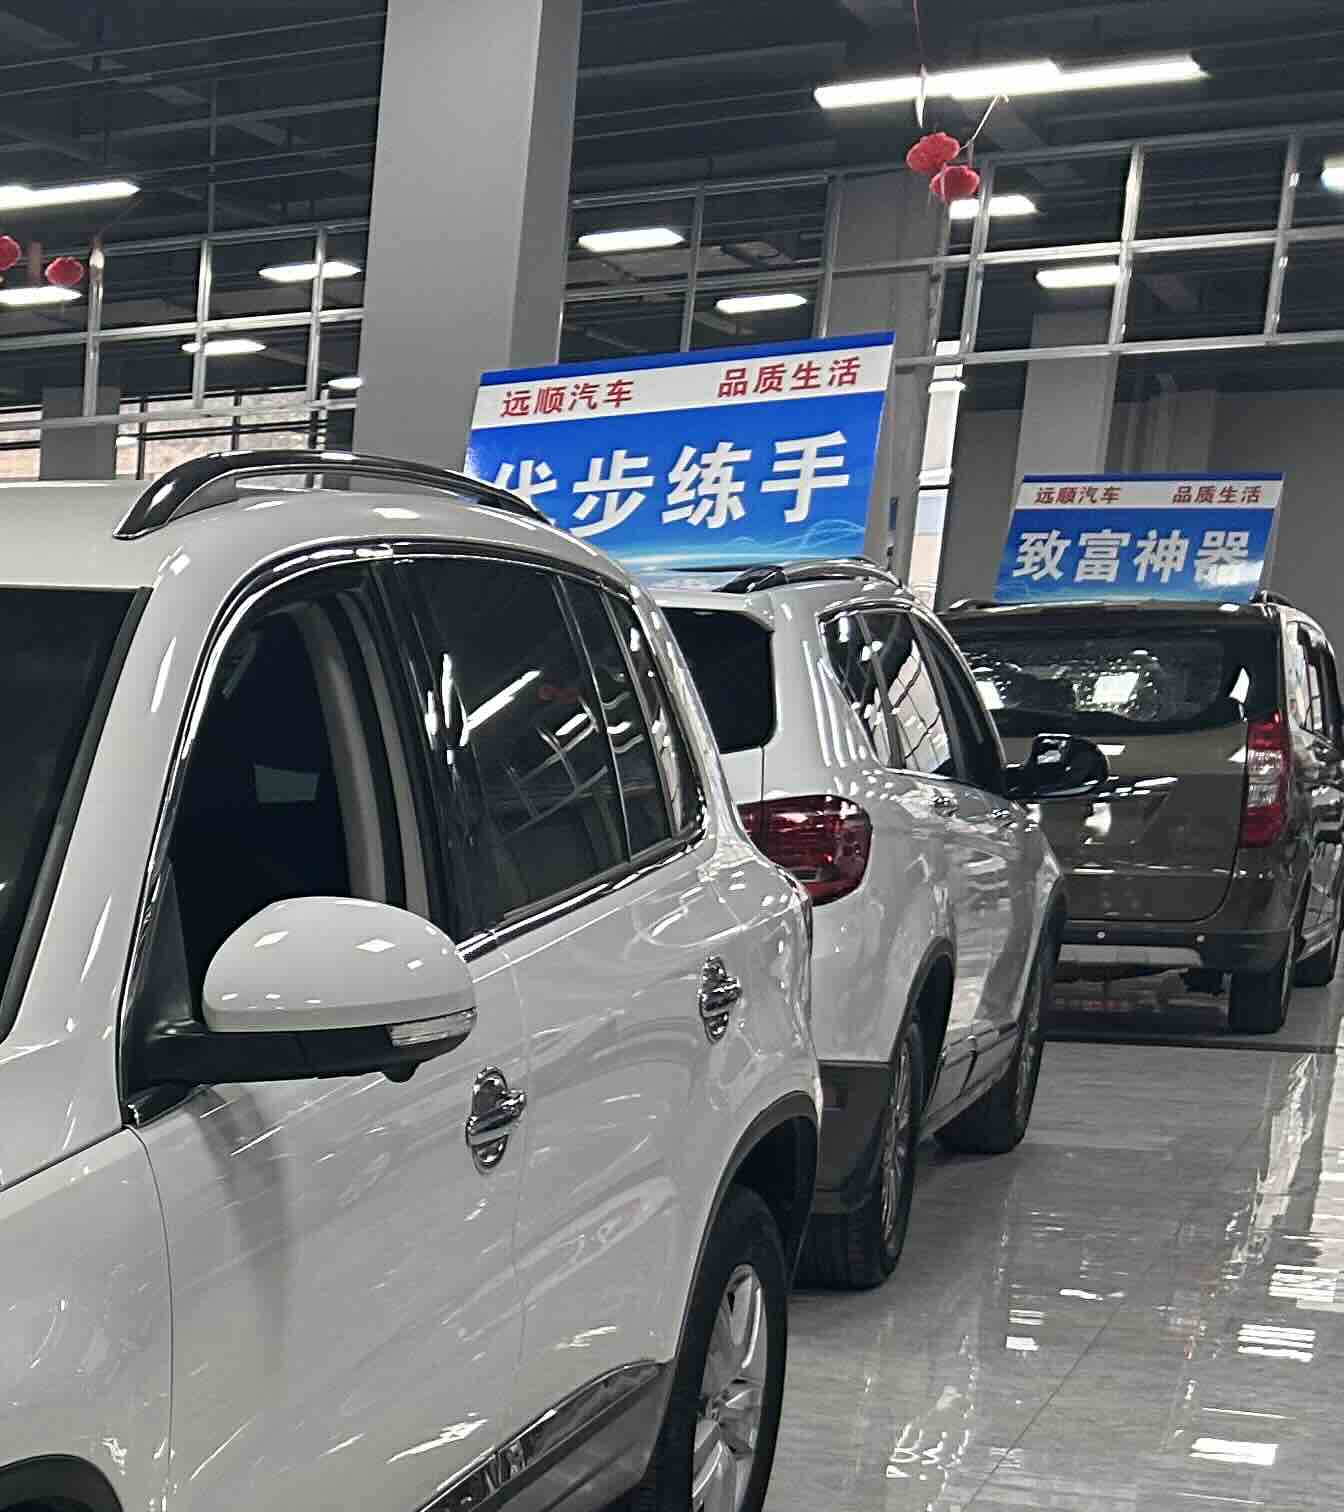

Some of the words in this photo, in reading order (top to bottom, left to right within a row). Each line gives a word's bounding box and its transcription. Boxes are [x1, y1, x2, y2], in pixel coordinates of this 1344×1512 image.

[501, 379, 634, 417] 远顺汽车
[718, 357, 861, 397] 品质生活
[1034, 486, 1122, 504] 远顺汽车
[1172, 486, 1264, 504] 品质生活
[1013, 530, 1250, 584] 致富神器
